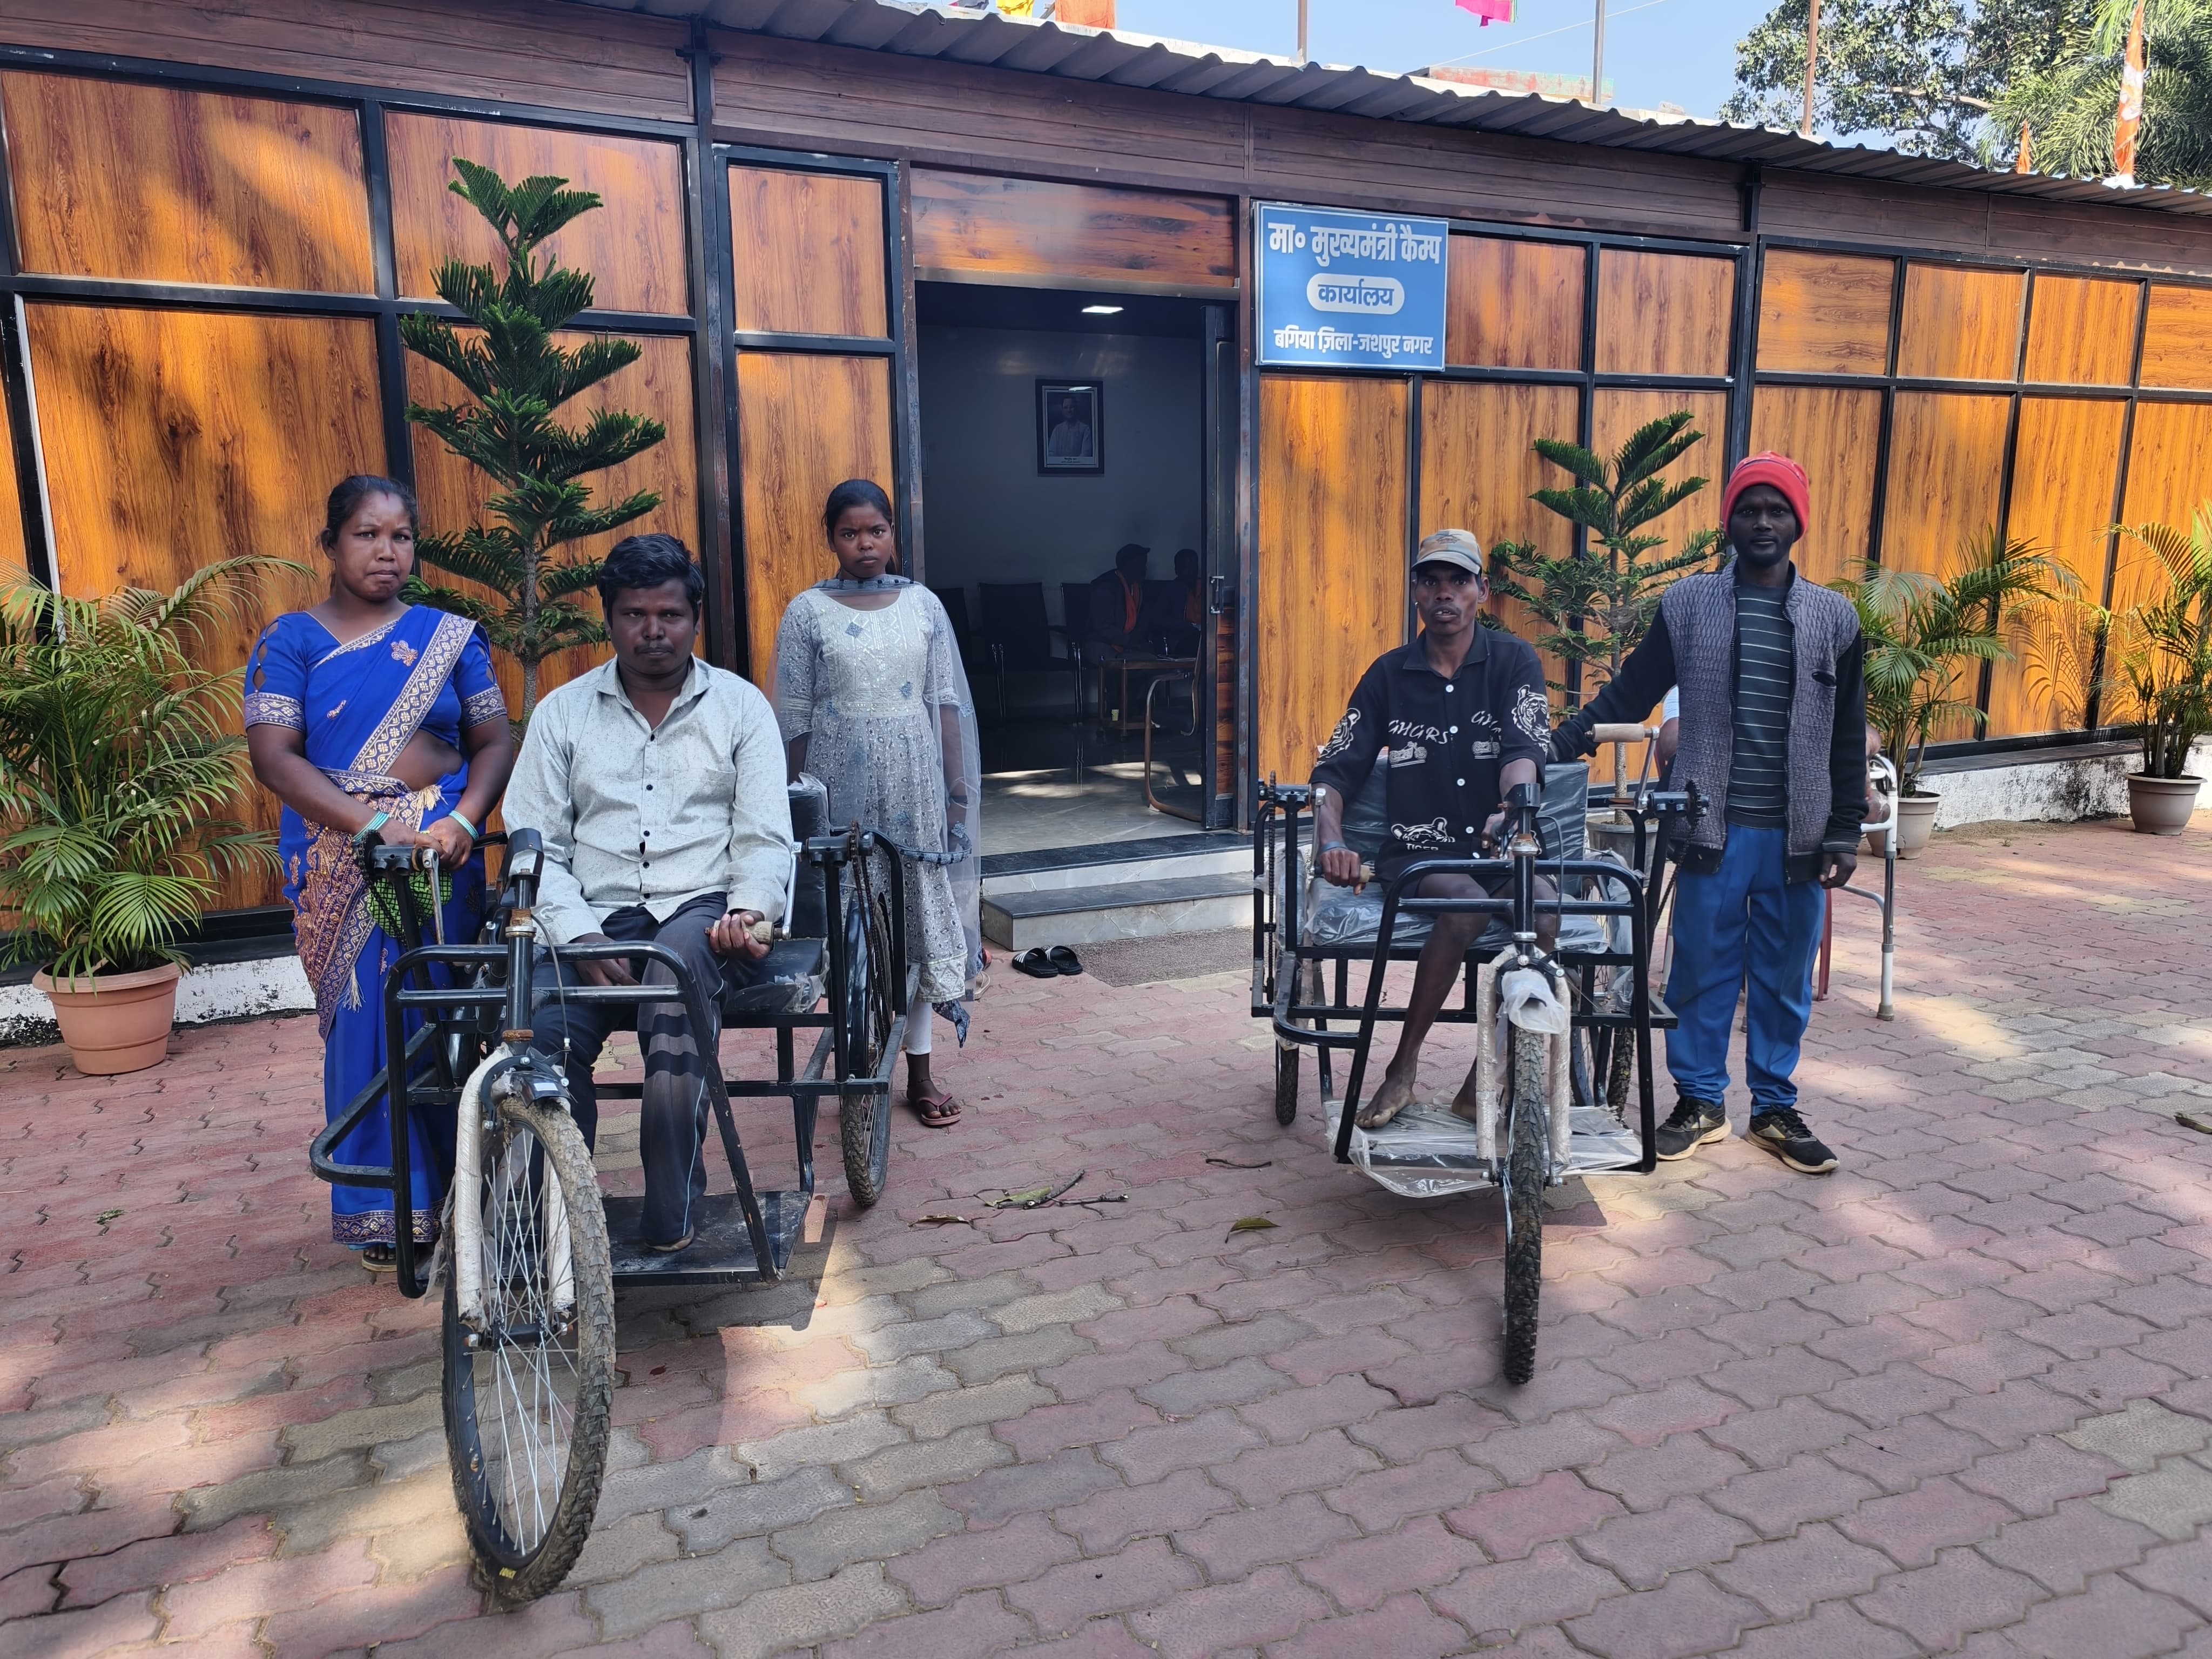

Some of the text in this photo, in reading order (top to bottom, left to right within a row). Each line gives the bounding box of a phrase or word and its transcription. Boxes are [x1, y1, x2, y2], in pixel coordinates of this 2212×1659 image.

[1310, 223, 1398, 267] मुख्यमंत्री
[1400, 224, 1442, 264] कैम्प
[1318, 279, 1394, 306] कार्यालय
[1273, 325, 1316, 349] बगिया
[1402, 335, 1433, 354] नगर
